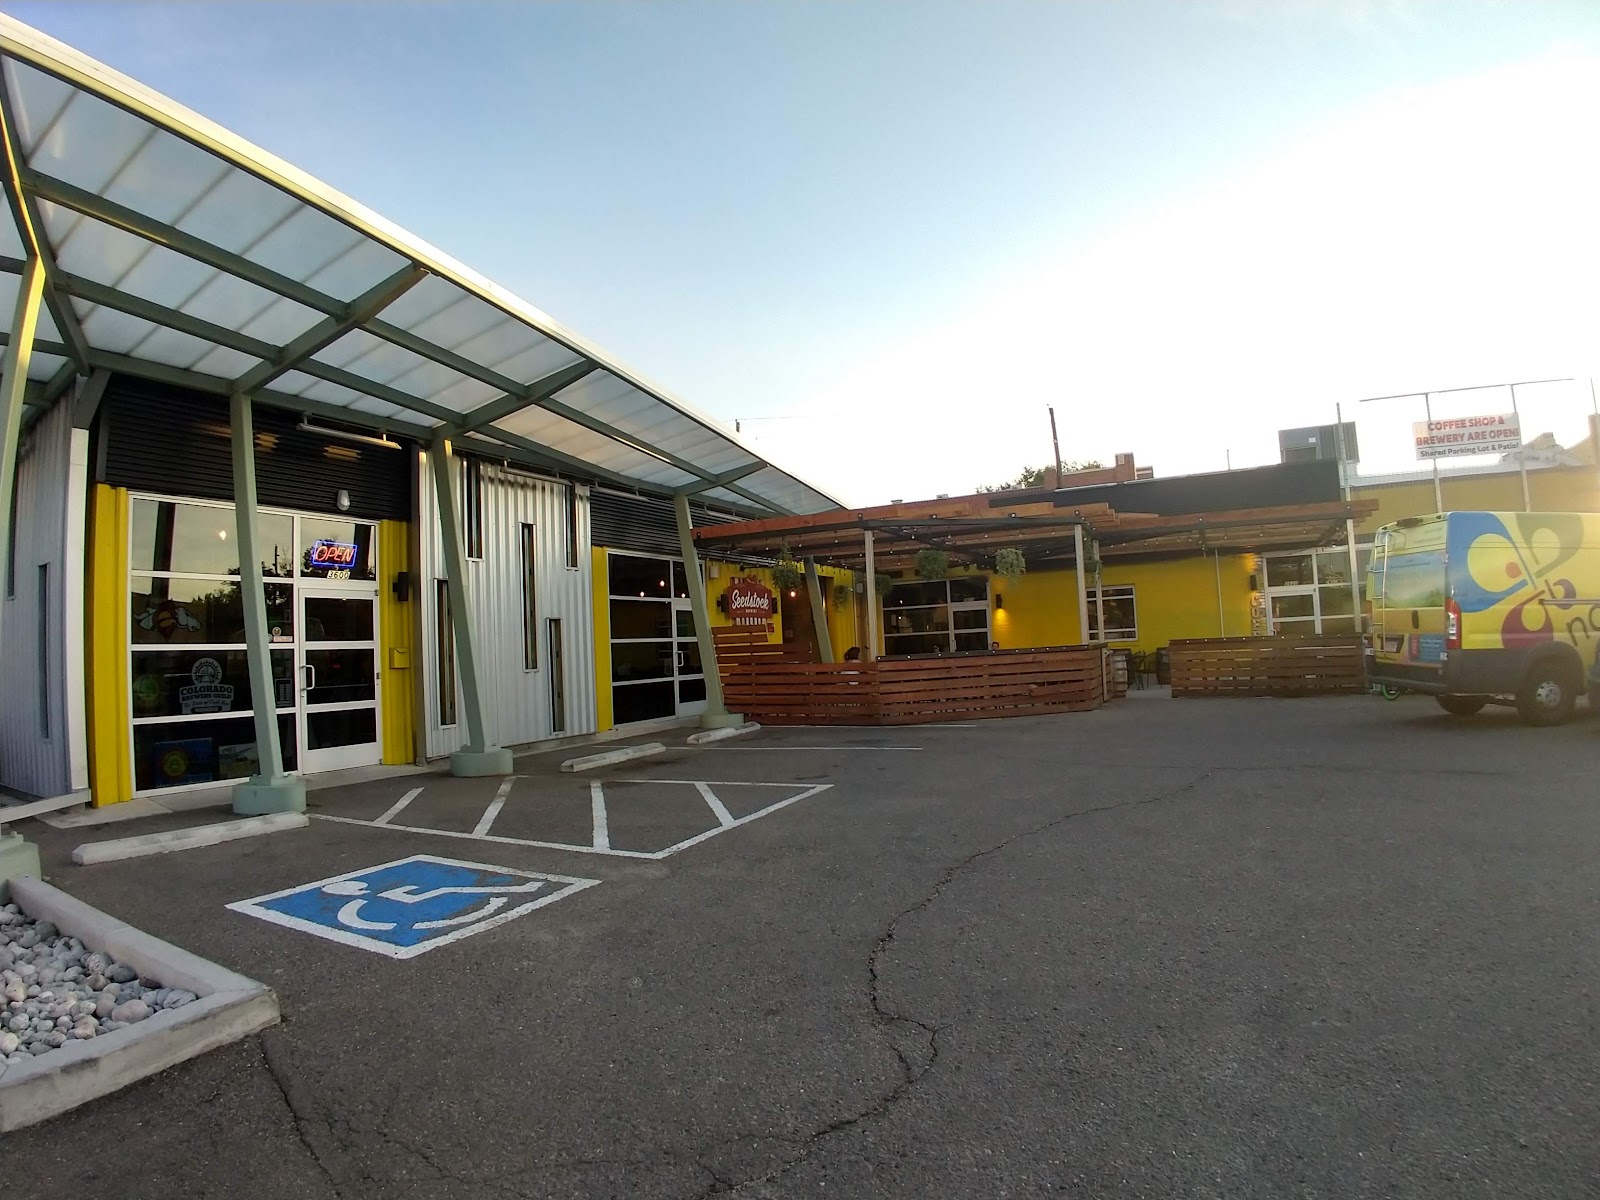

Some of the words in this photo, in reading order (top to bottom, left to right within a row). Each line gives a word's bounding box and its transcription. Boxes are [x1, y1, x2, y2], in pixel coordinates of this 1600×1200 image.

[1428, 418, 1467, 431] COFFEE
[1468, 416, 1497, 427] SHOP
[1498, 416, 1505, 424] &
[1416, 432, 1465, 446] BREWERY
[1467, 431, 1487, 441] ARE
[1489, 428, 1519, 439] OPEN!
[1420, 447, 1446, 457] Shared
[1448, 446, 1476, 454] Parking
[1478, 444, 1489, 452] Lot
[315, 546, 355, 562] OPEN
[328, 570, 350, 579] 3600
[732, 589, 769, 610] Seedstock
[180, 685, 232, 696] COLORADO
